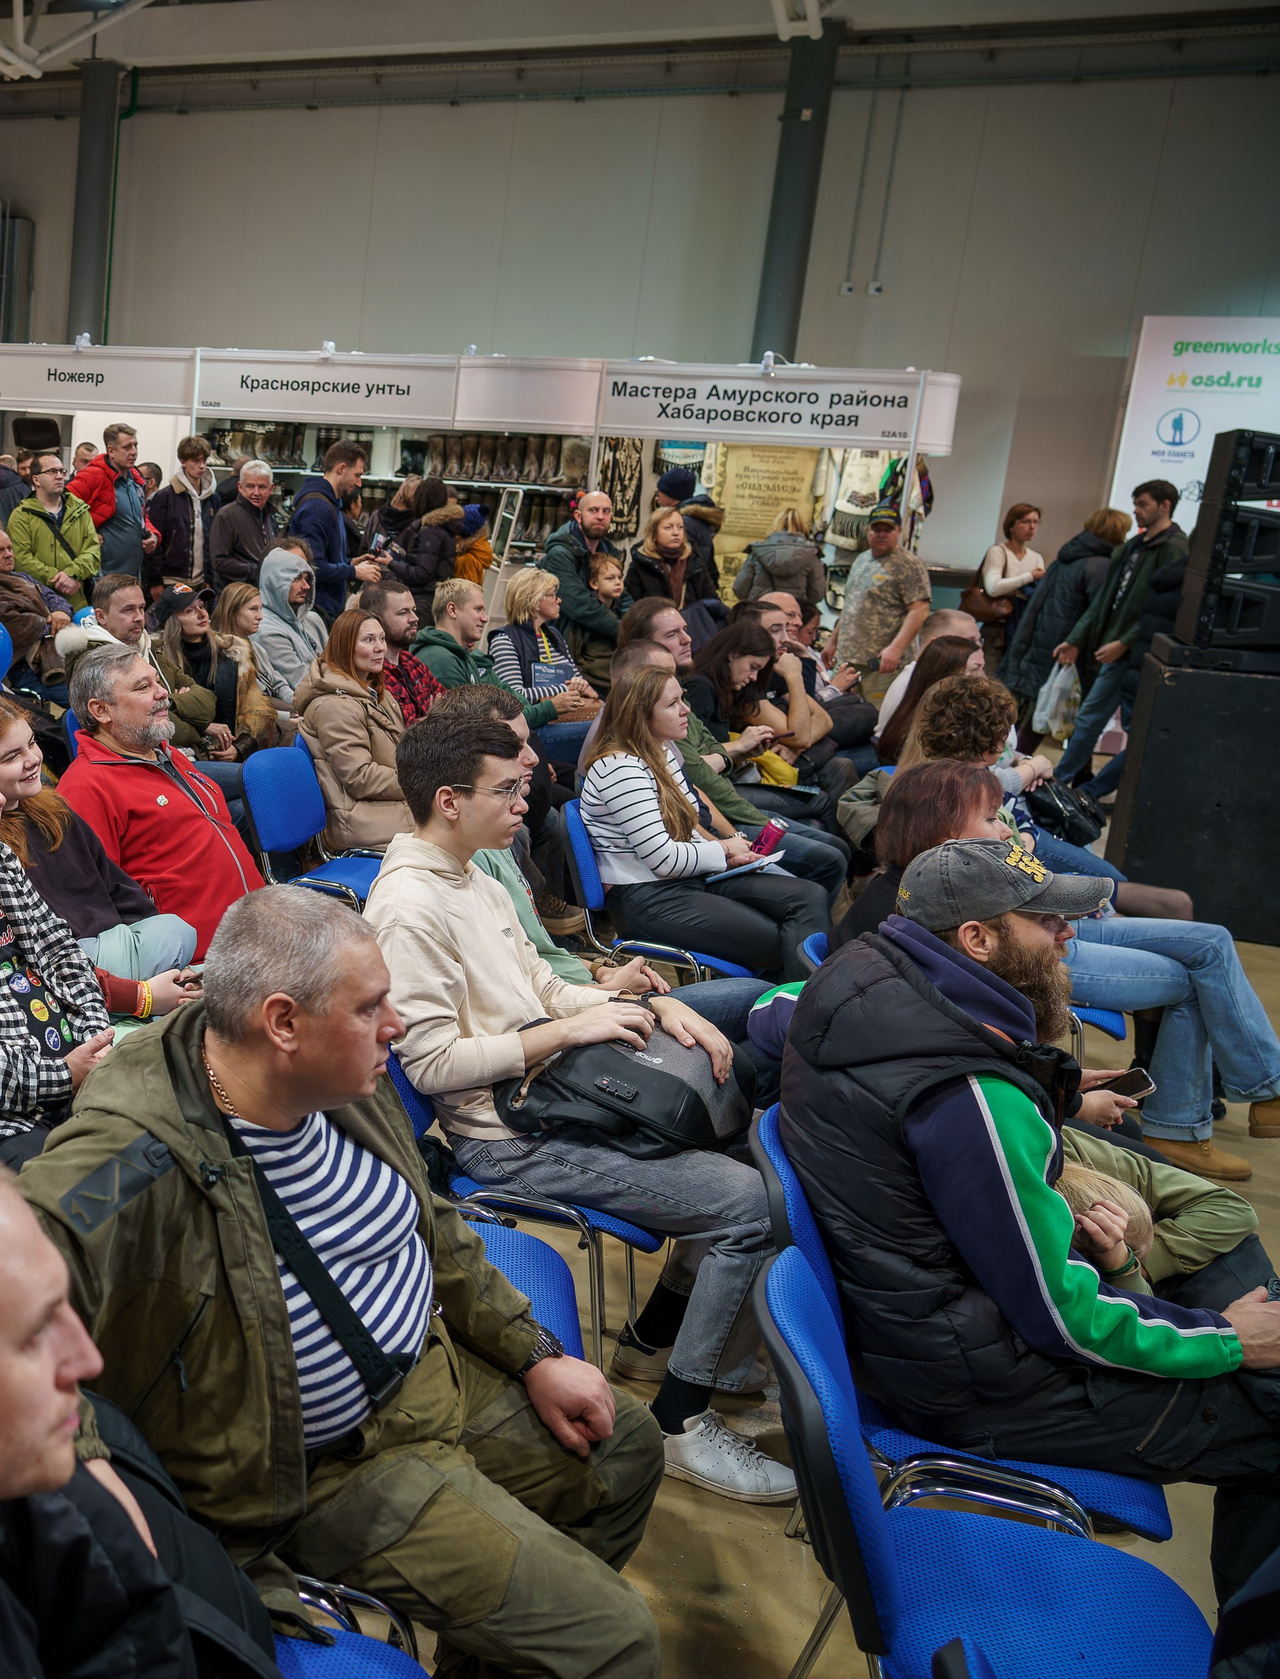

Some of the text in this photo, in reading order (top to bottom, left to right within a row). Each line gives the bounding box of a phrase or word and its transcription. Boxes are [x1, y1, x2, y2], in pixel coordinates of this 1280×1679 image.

[1172, 338, 1280, 356] greenworks
[47, 368, 105, 386] Ножеяр
[239, 374, 411, 398] Красноярские унты
[1191, 370, 1262, 388] osd.ru
[611, 381, 909, 410] Мастера Амурского района
[657, 403, 859, 430] Хабаровского края
